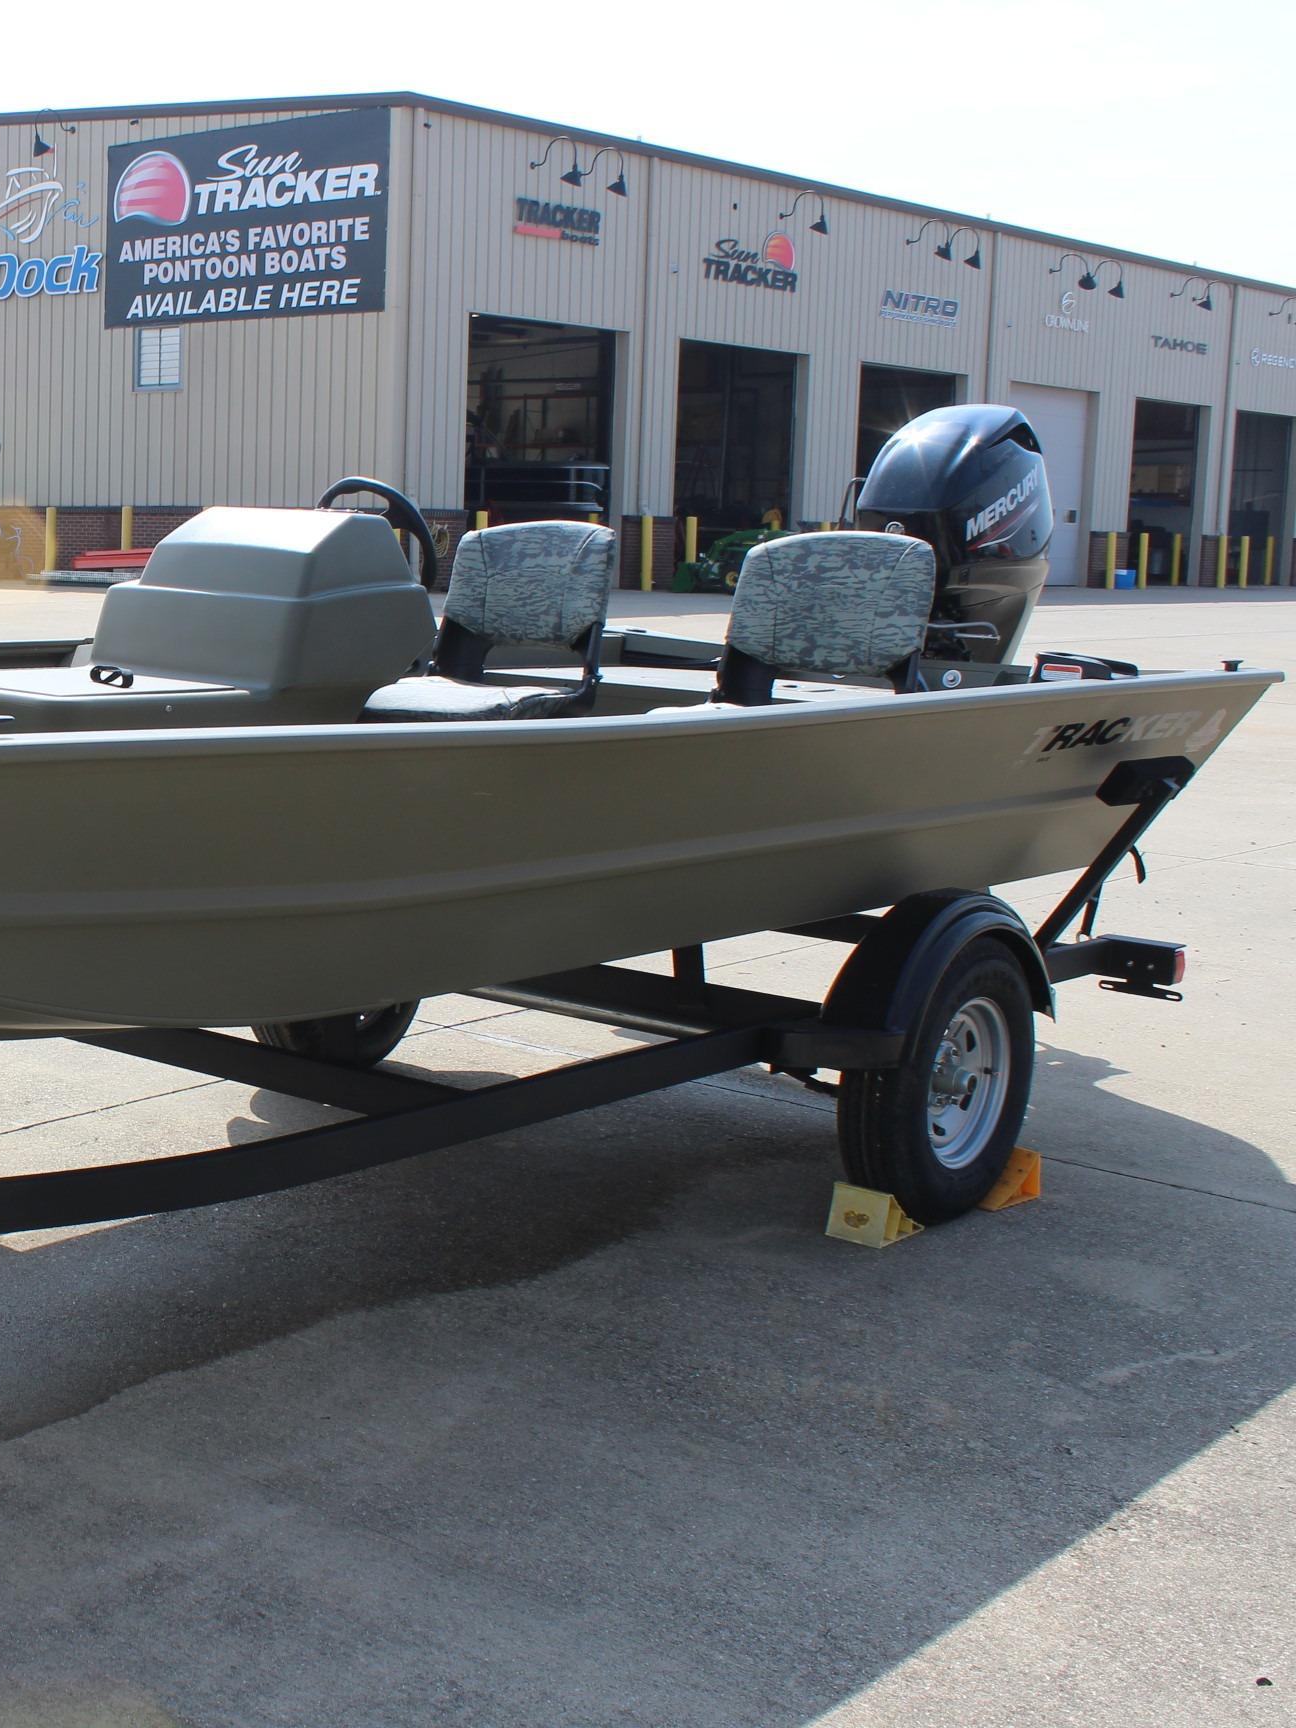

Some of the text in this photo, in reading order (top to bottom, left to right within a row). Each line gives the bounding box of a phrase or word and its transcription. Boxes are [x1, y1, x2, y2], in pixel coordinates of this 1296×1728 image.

[206, 143, 303, 181] Sun
[194, 162, 380, 216] TRACKER
[516, 197, 601, 234] TRACKER
[118, 216, 371, 264] AMERICA'S FAVORITE
[712, 238, 760, 264] Sun
[143, 245, 348, 286] PONTOON BOATS
[702, 257, 798, 294] TRACKER
[125, 277, 362, 320] AVAILABLE HERE
[882, 288, 959, 318] NITRO
[1151, 334, 1207, 355] TAHOE
[965, 463, 1039, 542] MERCURY
[1024, 711, 1201, 755] TRACKER
